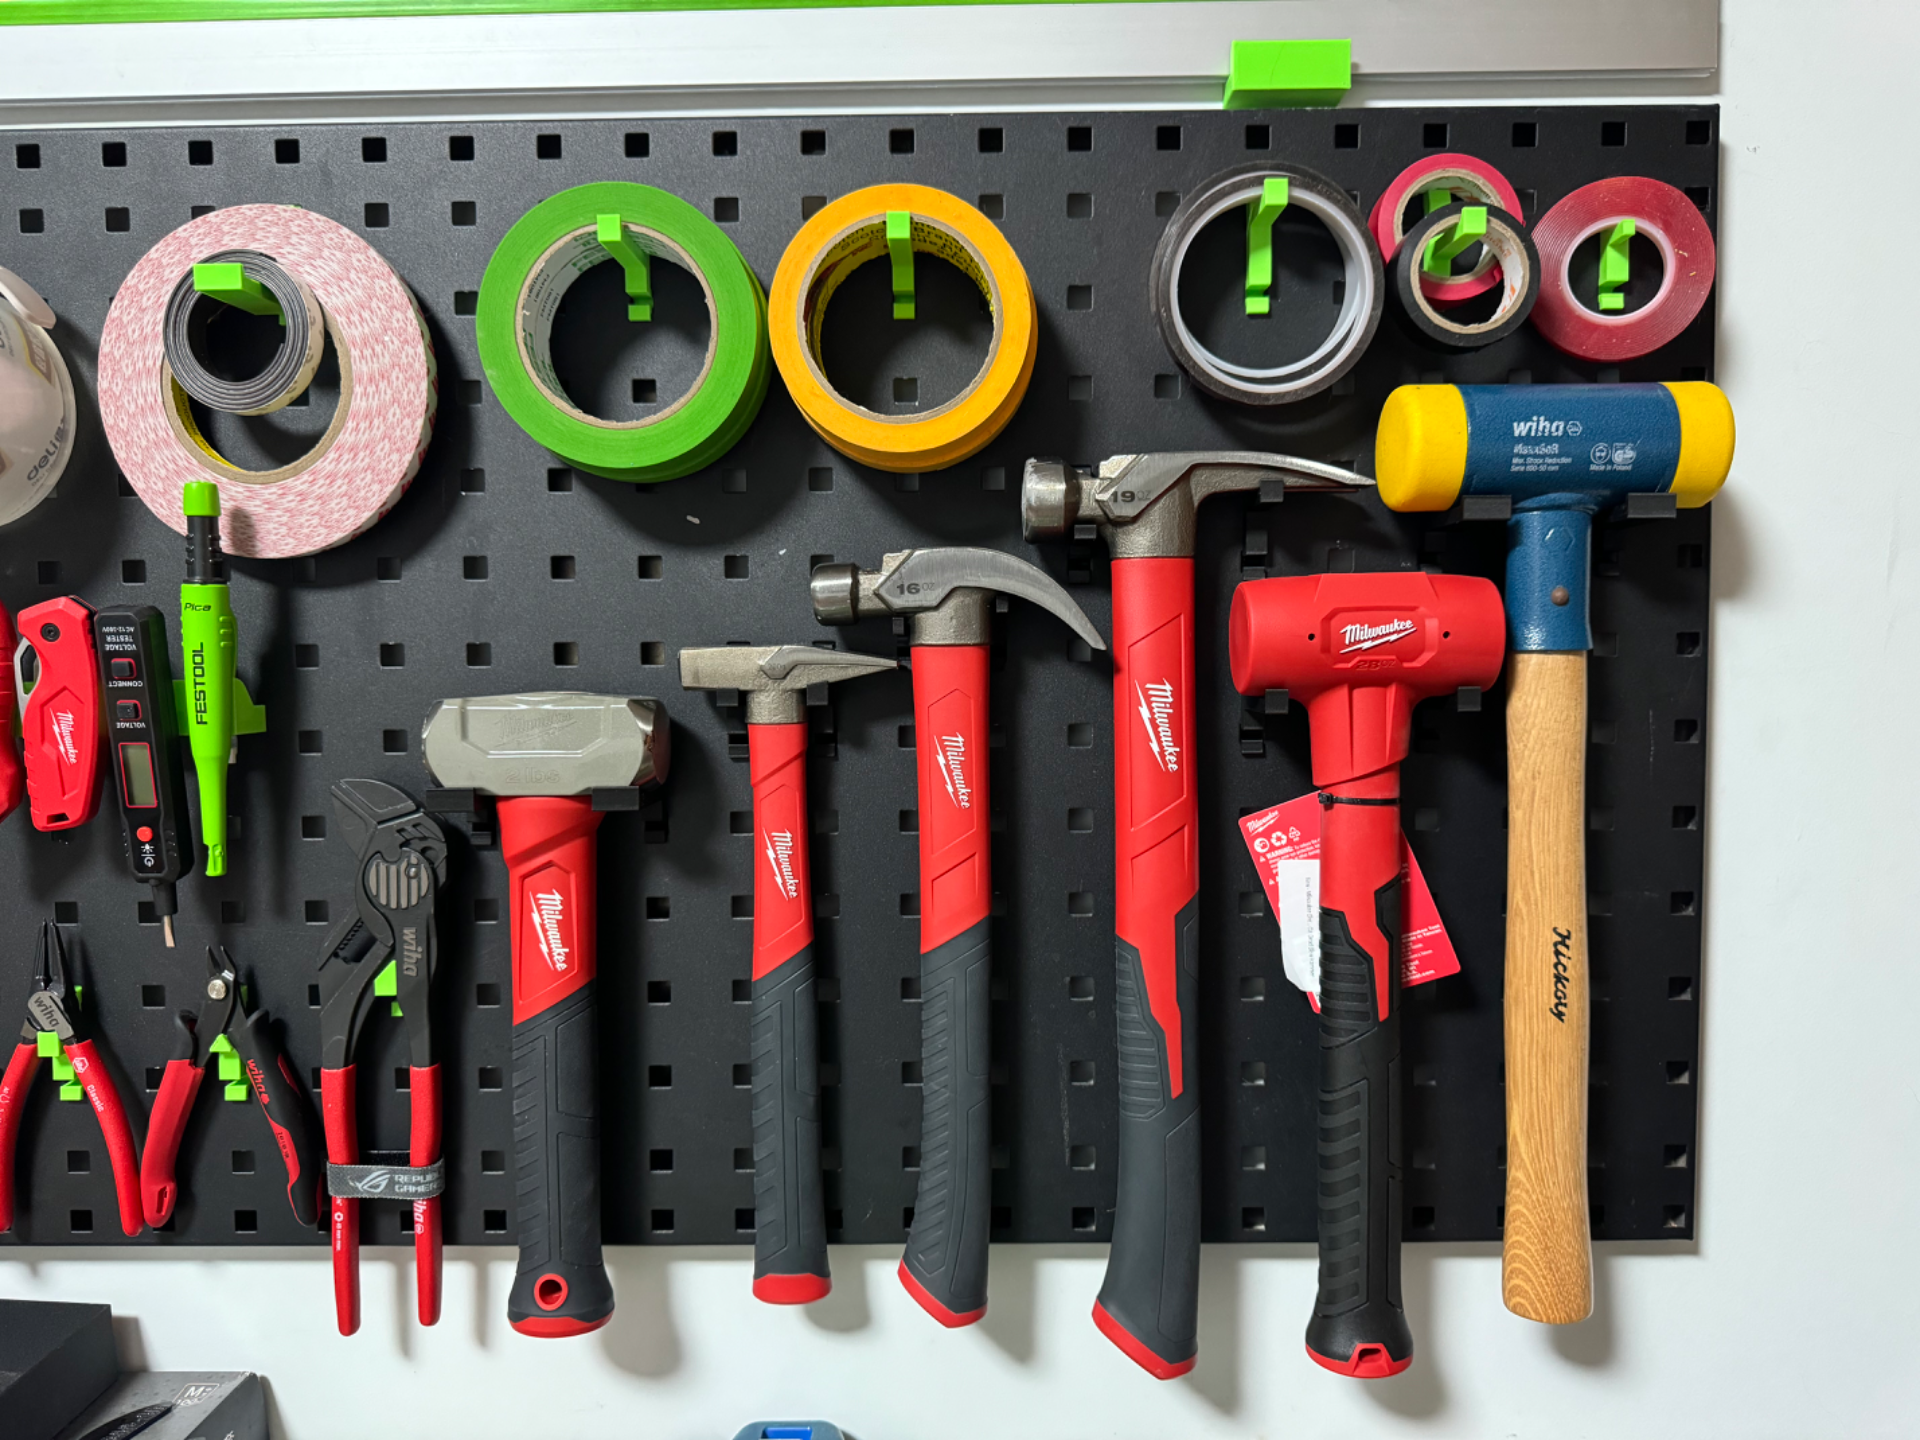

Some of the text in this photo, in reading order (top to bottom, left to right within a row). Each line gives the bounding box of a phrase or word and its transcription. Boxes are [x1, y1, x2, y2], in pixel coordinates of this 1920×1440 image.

[1513, 415, 1565, 437] wiha
[1110, 490, 1136, 503] 19
[896, 582, 921, 596] 16
[184, 602, 212, 611] Pica
[106, 634, 134, 642] TESTER
[1339, 618, 1414, 646] Milwaukee
[104, 643, 137, 651] VOLTAGE
[192, 641, 208, 725] FESTOOL
[56, 709, 78, 765] Milwaukee
[115, 721, 146, 729] VOLTAGE
[1144, 677, 1180, 773] Milwaukee
[941, 731, 971, 810] Milwaukee
[771, 828, 798, 899] Milwaukee
[536, 888, 570, 973] Milwaukee
[403, 926, 423, 977] wiha
[1549, 926, 1572, 1024] Hickory
[34, 997, 60, 1028] wiha
[247, 1059, 266, 1092] wiha
[87, 1084, 105, 1112] Classic
[413, 1197, 427, 1223] iha
